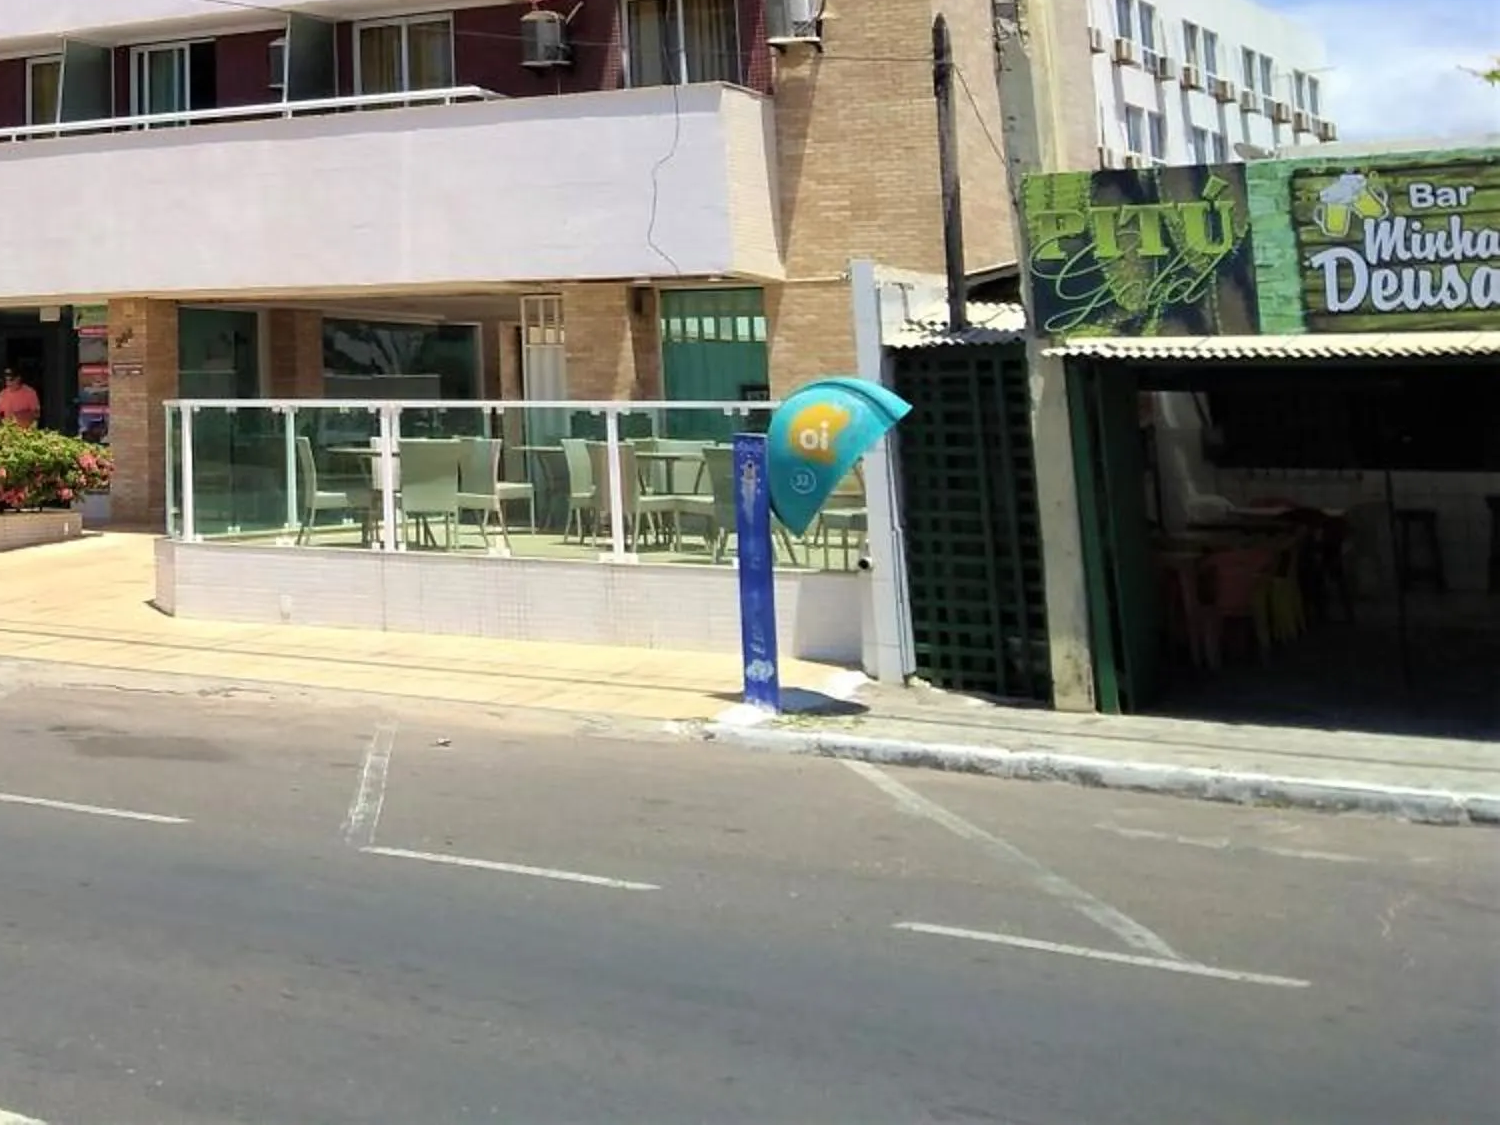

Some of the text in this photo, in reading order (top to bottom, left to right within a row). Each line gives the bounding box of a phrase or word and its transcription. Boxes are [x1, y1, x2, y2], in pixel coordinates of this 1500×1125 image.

[1409, 182, 1476, 209] Bar
[1363, 214, 1500, 266] Minha
[1030, 225, 1246, 332] Gold
[1308, 246, 1500, 313] Deusa
[800, 421, 829, 450] oi
